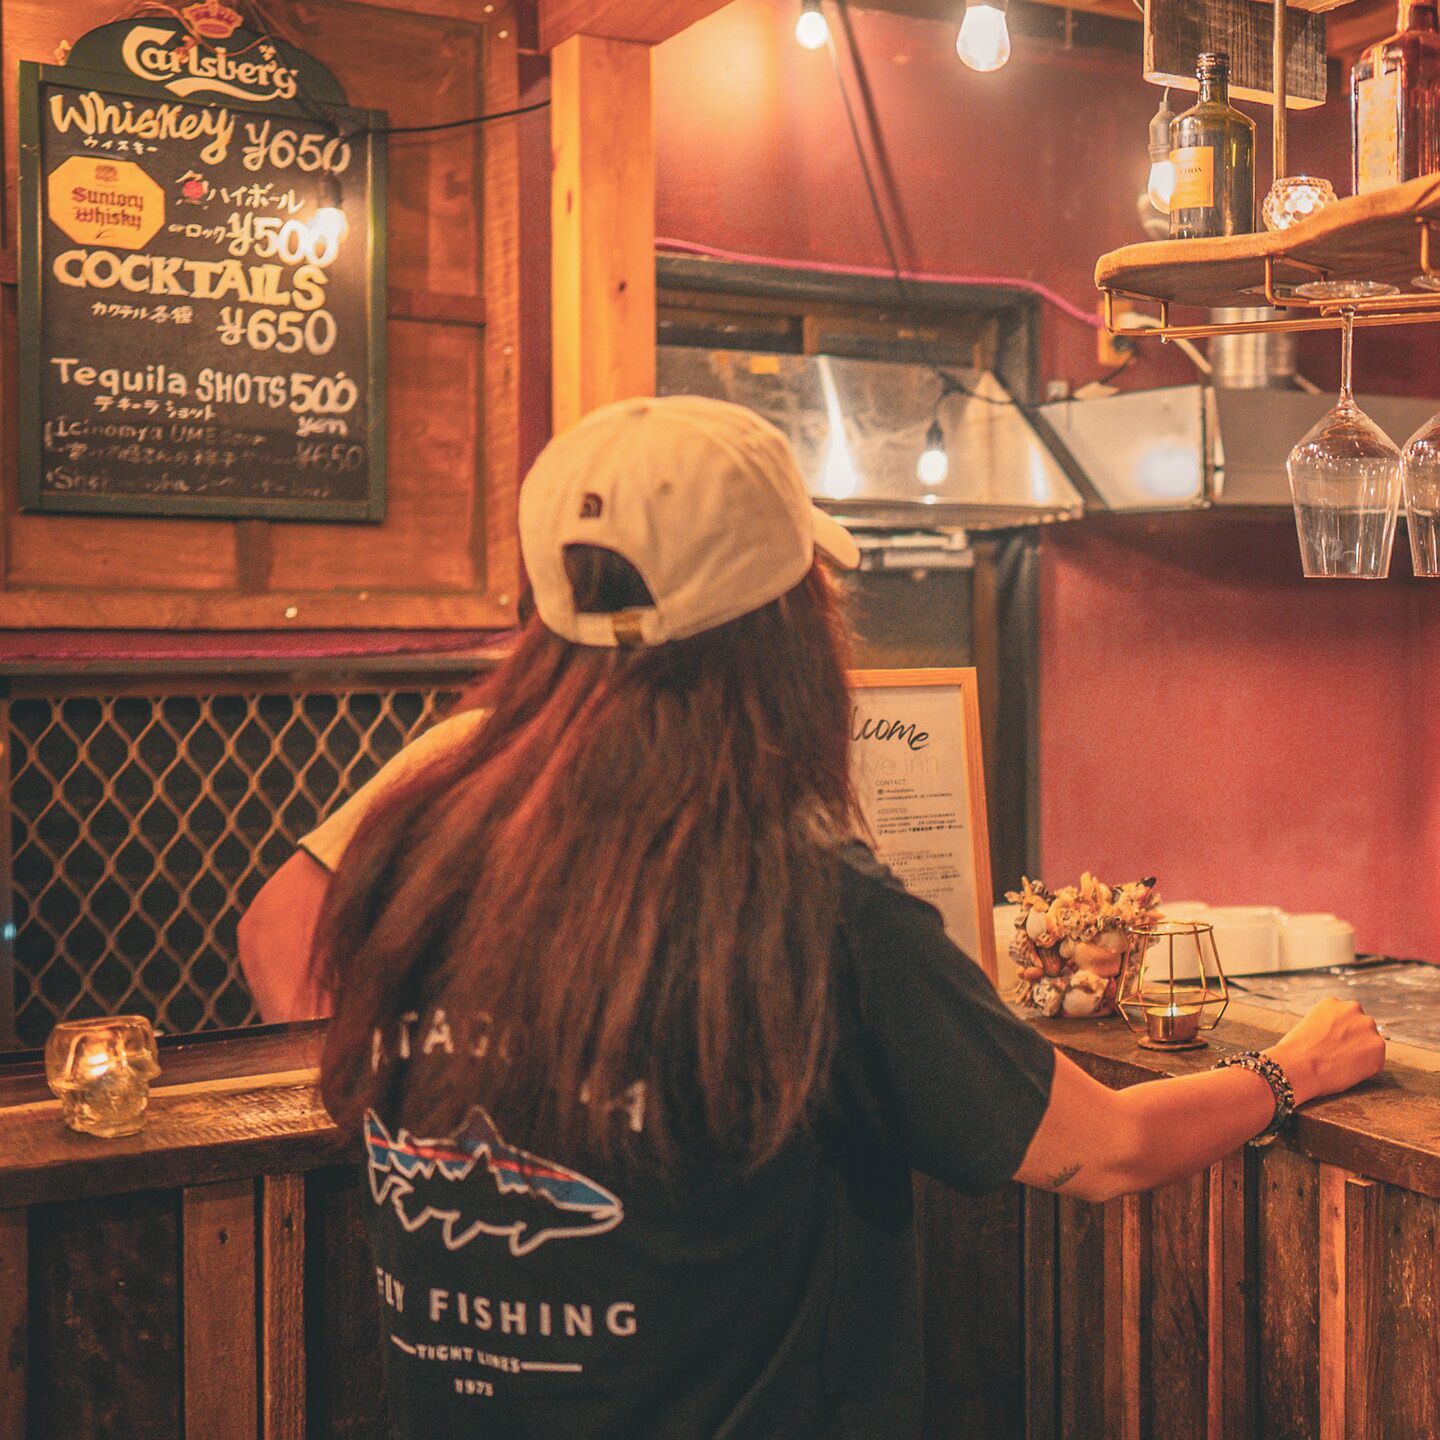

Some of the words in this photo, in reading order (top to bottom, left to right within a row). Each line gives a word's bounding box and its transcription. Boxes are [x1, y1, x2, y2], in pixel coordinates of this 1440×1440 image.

[122, 26, 299, 100] Carlsberg
[71, 186, 145, 212] Suntory
[74, 205, 142, 231] Whisky
[52, 249, 329, 311] COCKTAILS
[50, 357, 189, 397] Tequila
[195, 367, 288, 409] SHOTS
[851, 705, 930, 751] lcome
[429, 1288, 638, 1338] FISHING
[416, 1343, 474, 1362] TIGHT
[477, 1350, 521, 1374] LINES
